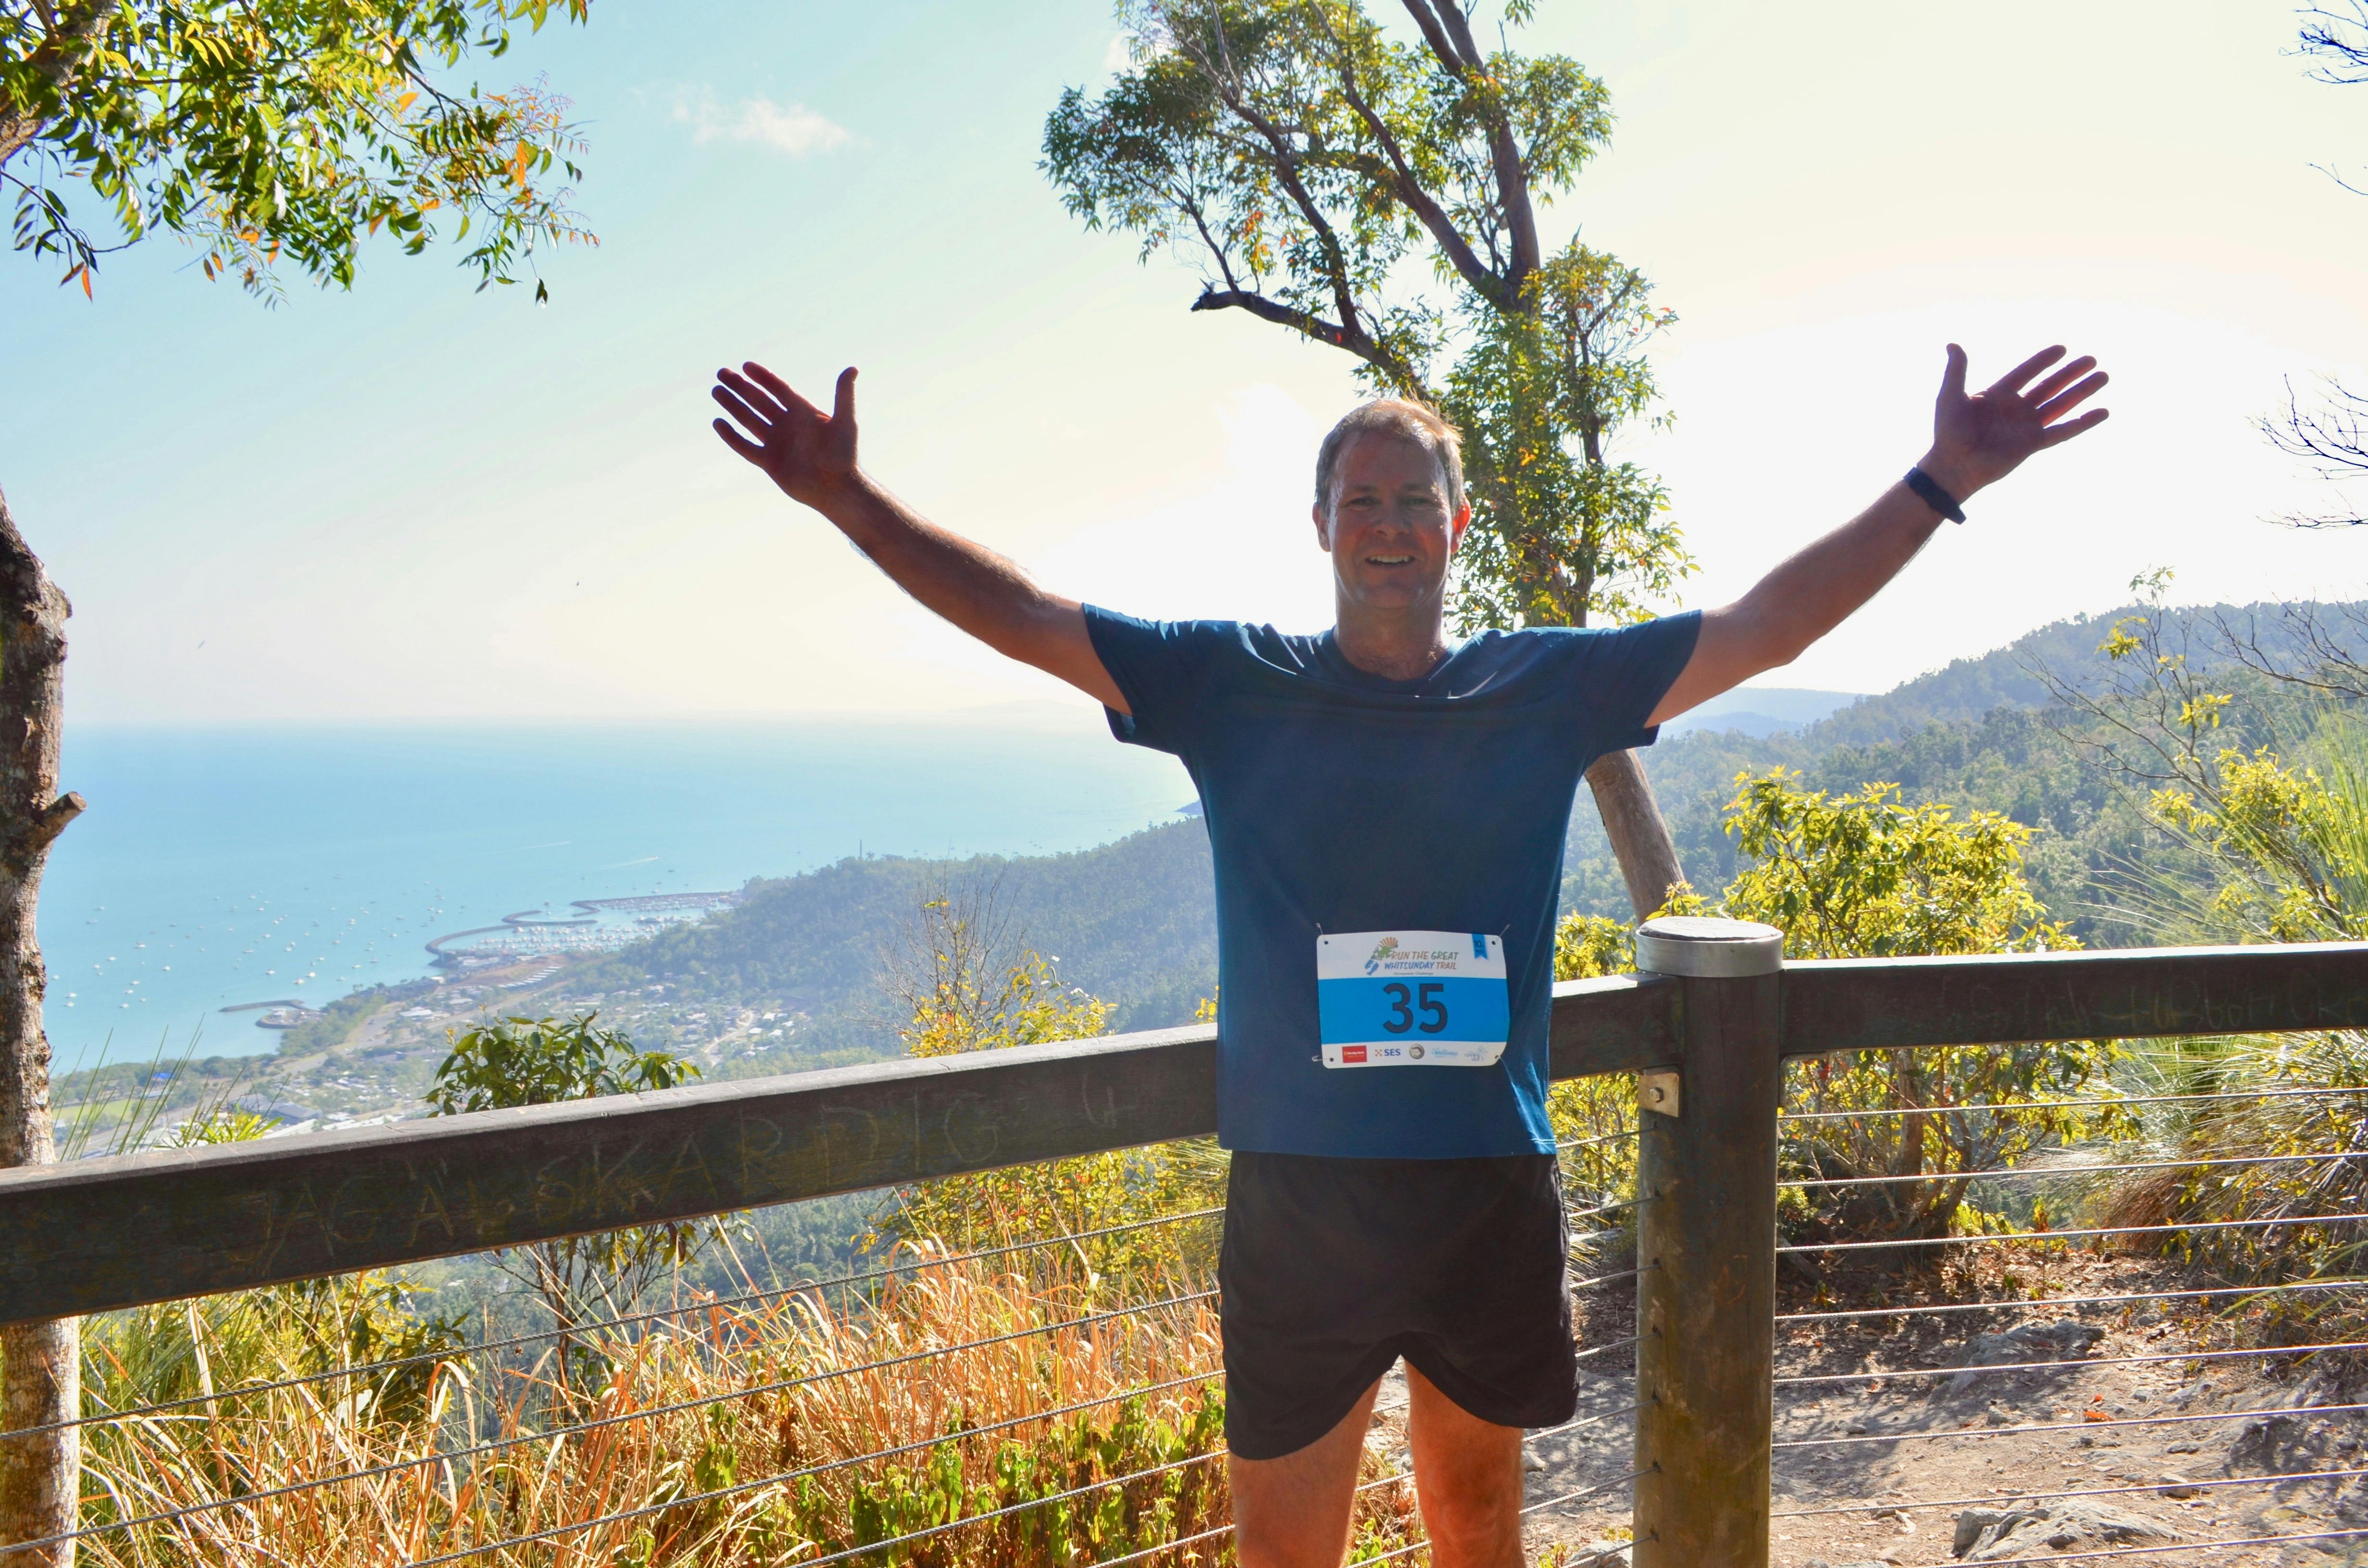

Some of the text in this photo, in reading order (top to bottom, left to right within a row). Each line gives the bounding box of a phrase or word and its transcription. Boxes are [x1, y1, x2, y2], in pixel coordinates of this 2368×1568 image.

[1391, 951, 1459, 960] RUN THE GREAT
[1384, 961, 1457, 970] WHITSUNDAY TRAIL
[1382, 982, 1448, 1034] 35
[1384, 1048, 1401, 1056] SES
